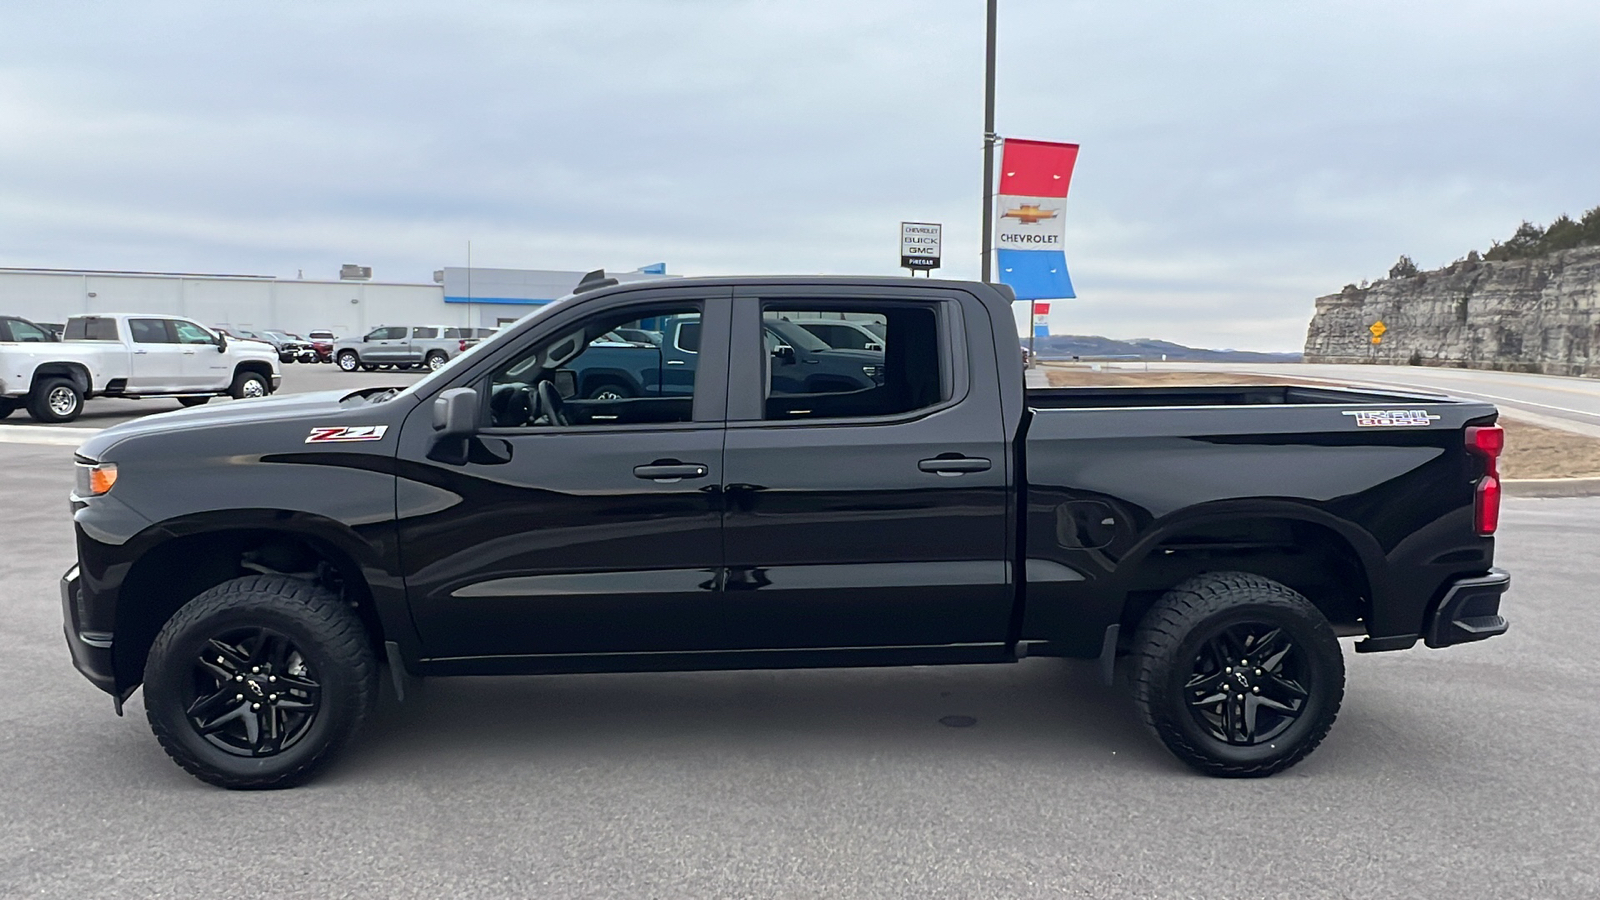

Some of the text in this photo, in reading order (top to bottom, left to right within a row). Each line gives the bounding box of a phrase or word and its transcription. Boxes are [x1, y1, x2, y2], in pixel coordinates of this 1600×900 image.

[1000, 233, 1058, 243] CHEVROLET
[1342, 410, 1440, 419] TRAIL
[1357, 418, 1430, 426] BOSS
